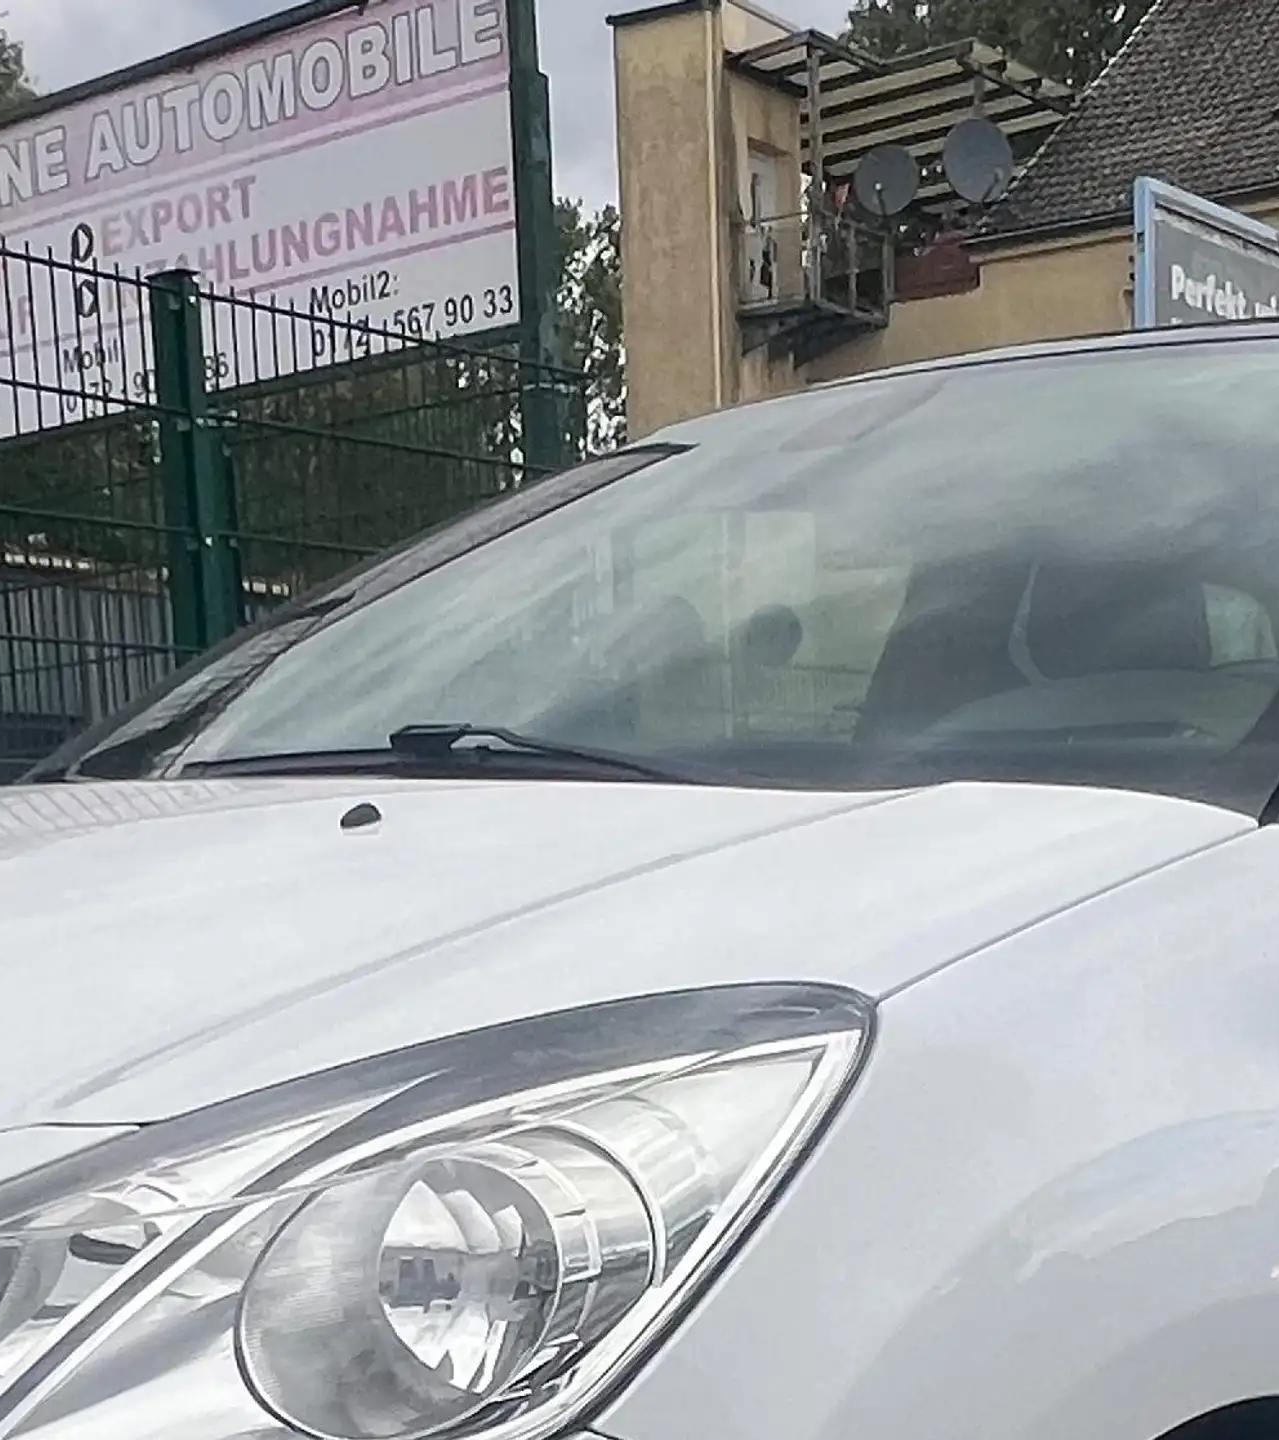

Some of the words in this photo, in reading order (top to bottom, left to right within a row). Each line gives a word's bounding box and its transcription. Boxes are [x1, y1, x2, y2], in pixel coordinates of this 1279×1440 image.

[84, 0, 504, 183] AUTOMOBILE
[100, 175, 257, 257] EXPORT
[310, 270, 399, 314] Mobil2:
[444, 294, 473, 326] 90
[483, 284, 513, 318] 33
